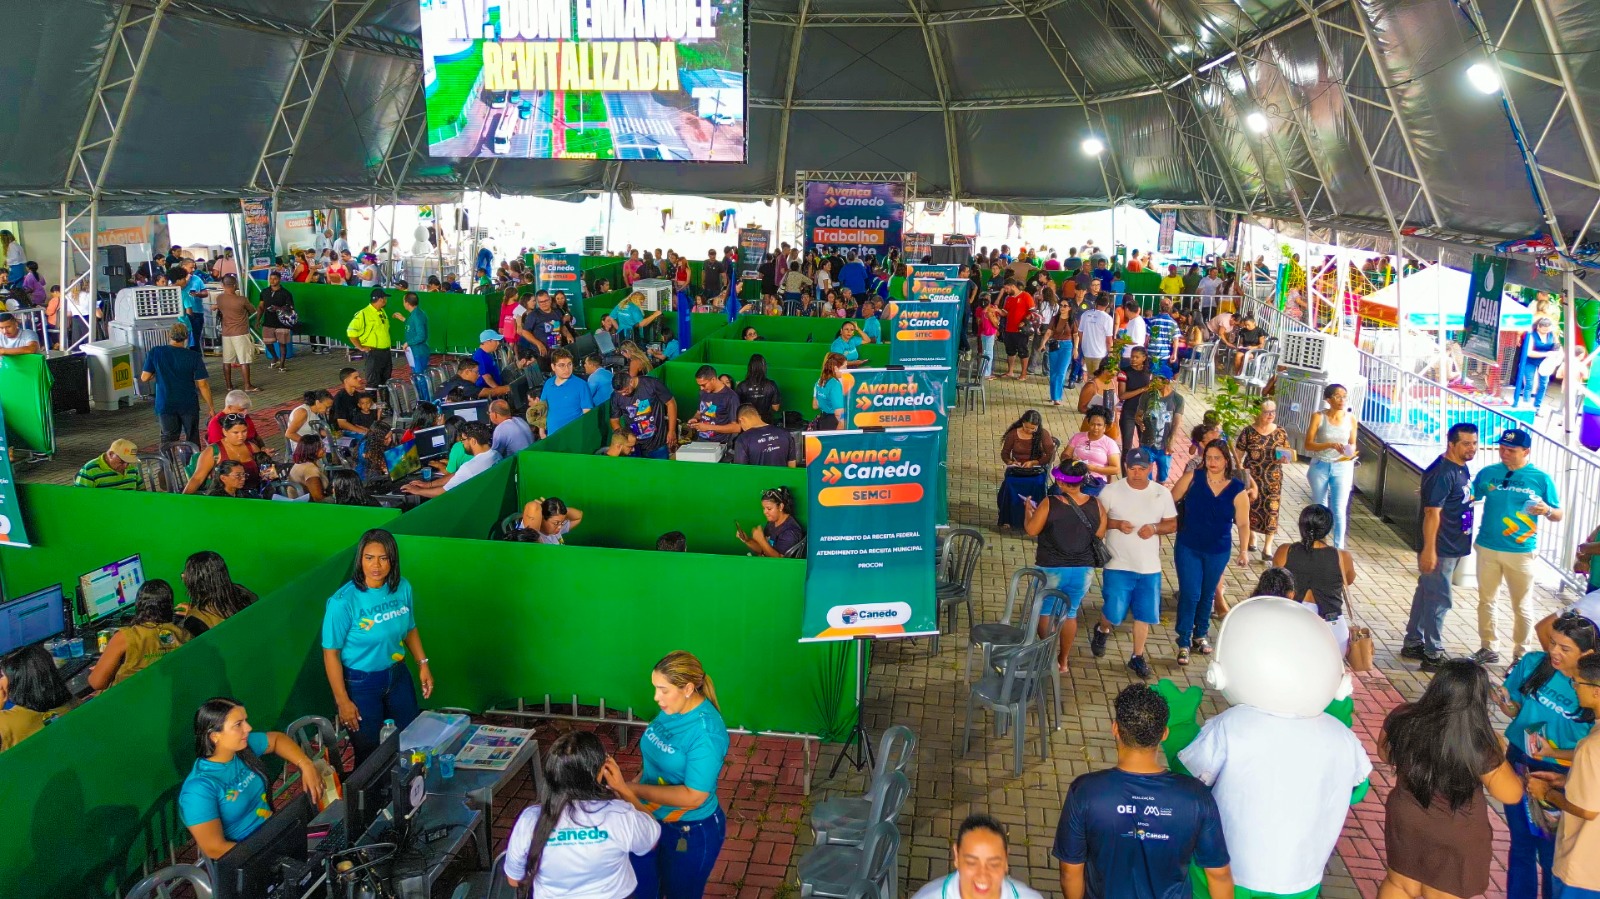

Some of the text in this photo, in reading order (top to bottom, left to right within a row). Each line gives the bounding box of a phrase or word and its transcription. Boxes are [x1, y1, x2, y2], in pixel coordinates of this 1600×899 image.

[450, 0, 715, 39] AV. DOM EMANUEL
[483, 41, 679, 91] REVITALIZADA
[825, 186, 872, 198] Avança
[838, 196, 885, 207] Canedo
[816, 215, 889, 229] Cidadania
[815, 228, 879, 243] Trabalho
[899, 310, 939, 319] Avança
[1471, 291, 1499, 327] ÁGUA
[909, 317, 949, 327] Canedo
[856, 381, 918, 397] Avança
[872, 393, 935, 408] Canedo
[879, 414, 912, 423] SEHAB
[823, 446, 902, 466] Avança
[844, 461, 921, 480] Canedo
[852, 489, 892, 501] SEMCI
[859, 609, 898, 619] Canedo
[644, 727, 676, 755] Canedo
[238, 771, 256, 793] Cane
[1117, 804, 1136, 814] OEI
